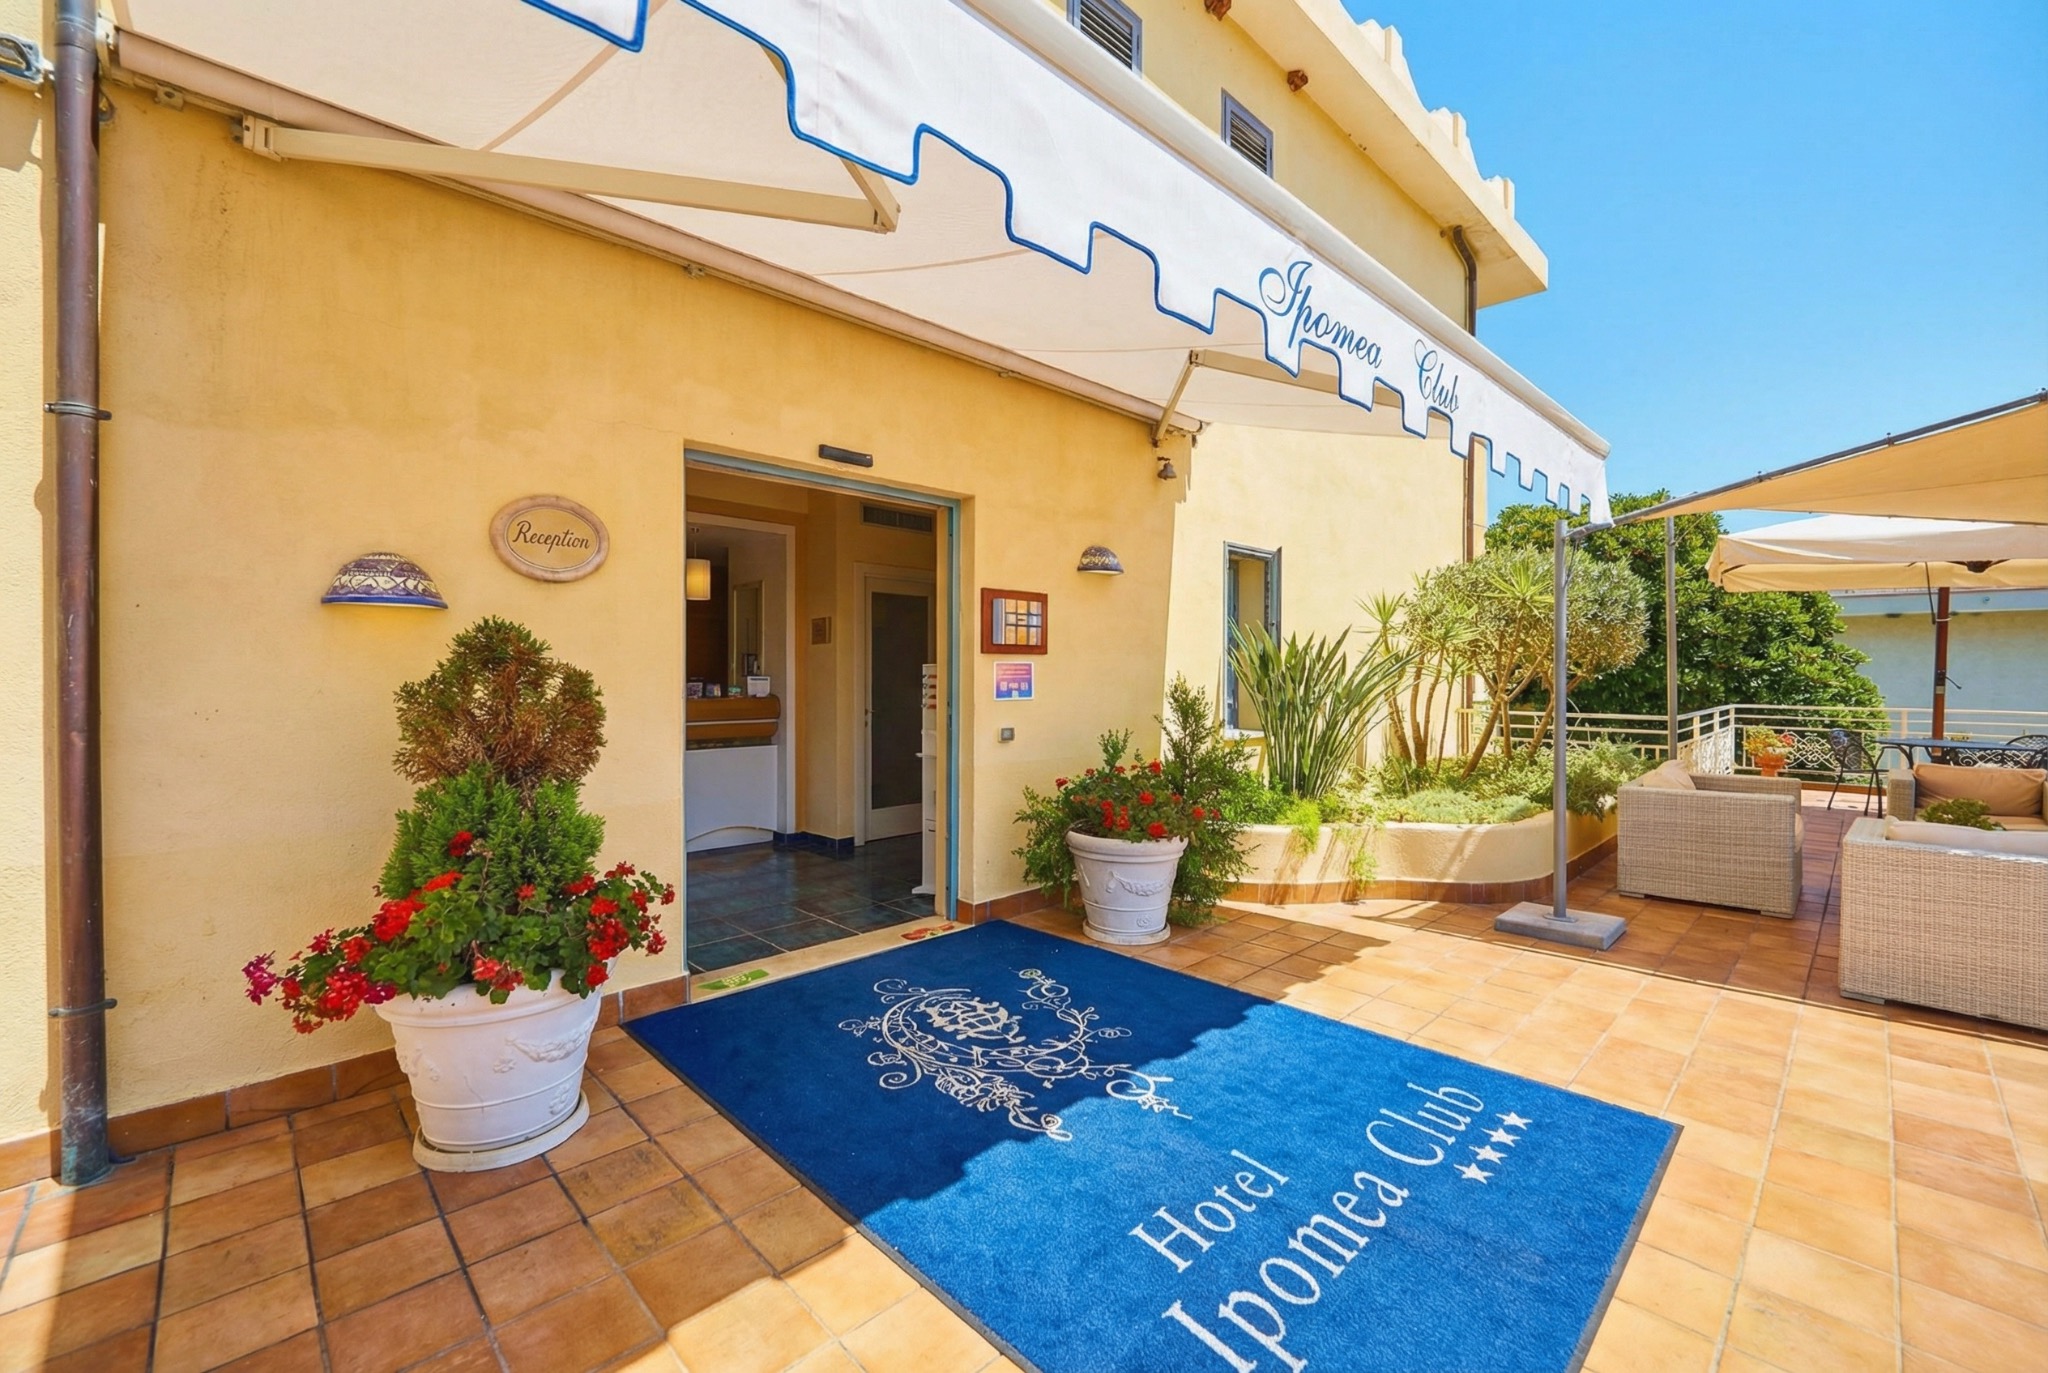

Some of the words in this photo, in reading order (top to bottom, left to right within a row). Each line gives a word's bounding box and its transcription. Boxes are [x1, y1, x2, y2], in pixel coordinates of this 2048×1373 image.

[1258, 260, 1383, 369] Ipomea
[1413, 338, 1460, 414] Club
[511, 519, 590, 554] Reception
[1128, 1148, 1290, 1274] Hotel
[1160, 1168, 1410, 1373] Ipomea
[1365, 1081, 1486, 1167] Club
